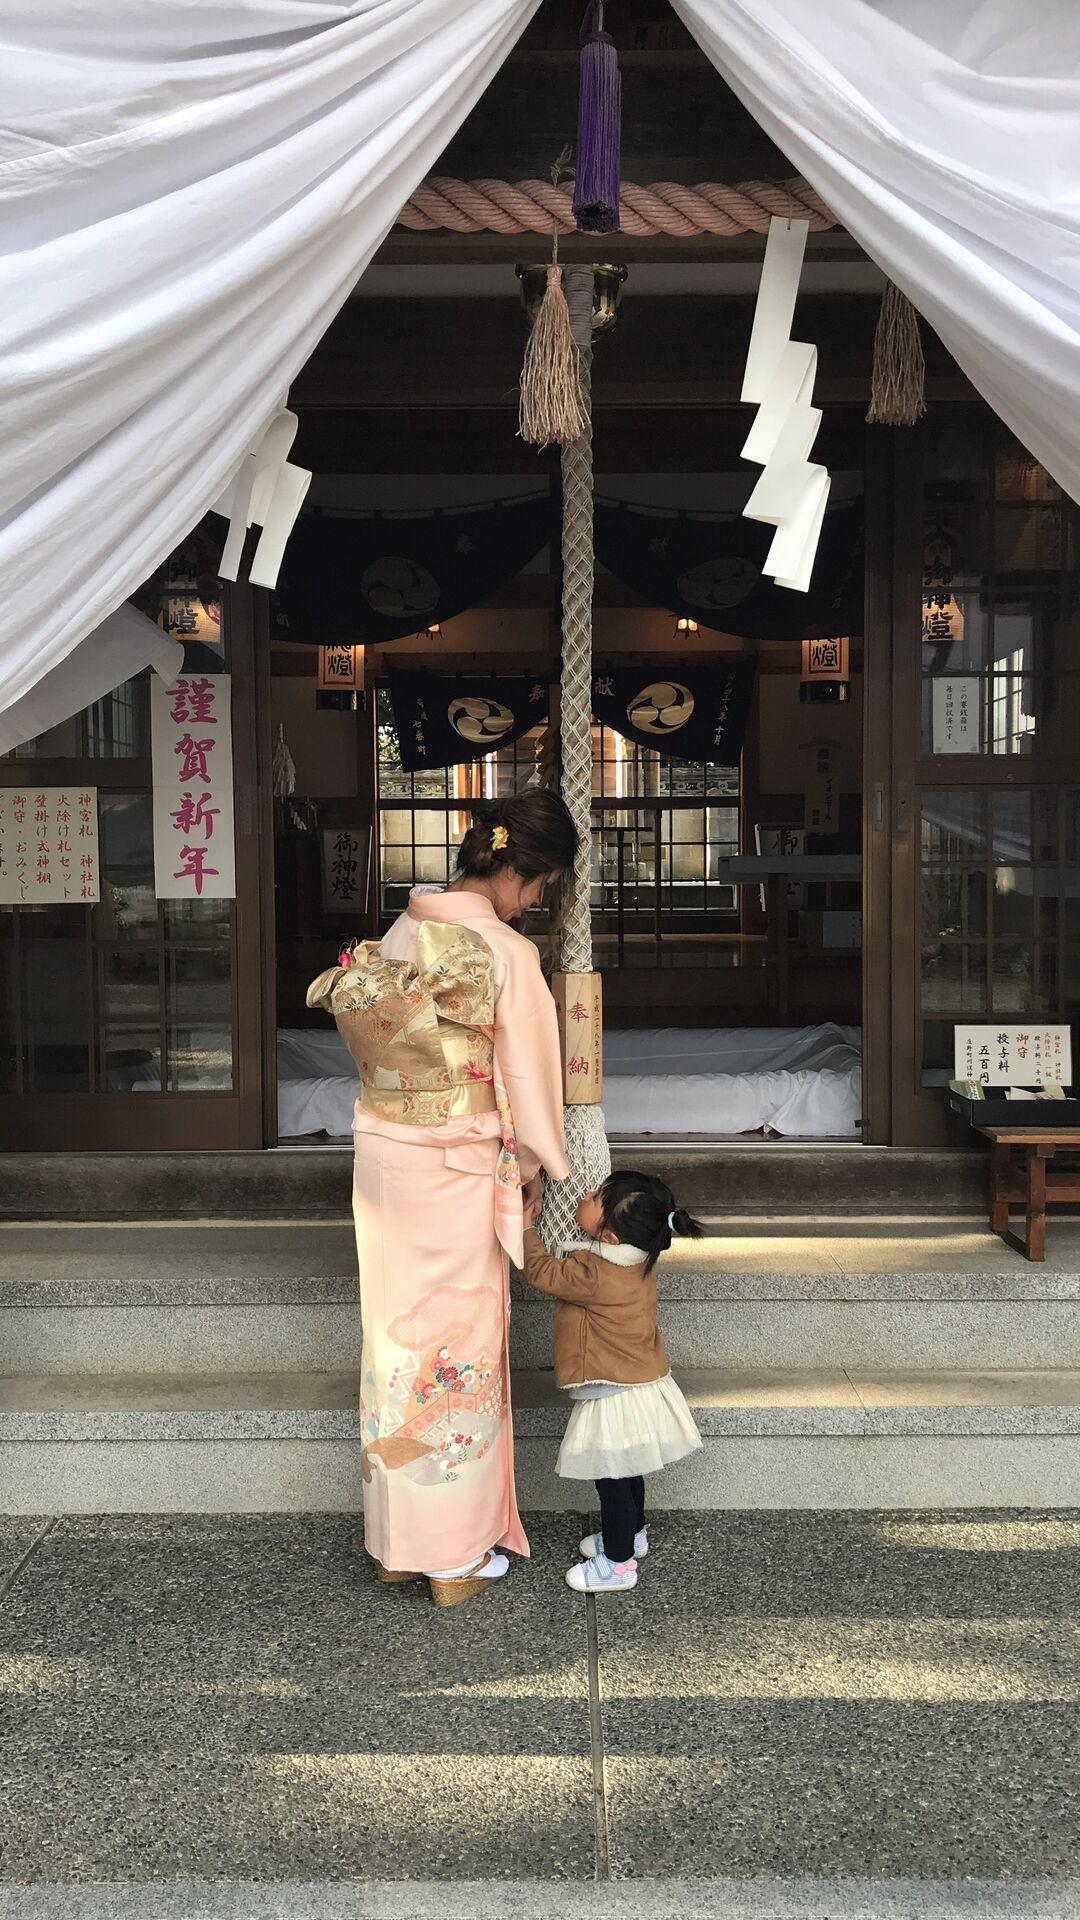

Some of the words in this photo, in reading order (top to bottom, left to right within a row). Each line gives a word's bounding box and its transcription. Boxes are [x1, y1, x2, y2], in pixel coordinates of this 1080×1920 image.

[812, 639, 838, 667] 燈
[528, 687, 545, 703] 奉
[960, 685, 968, 732] この賽銭箱は
[165, 678, 221, 895] 謹賀新年
[78, 793, 93, 837] 神宮札
[12, 796, 29, 900] 御守・おみくじ
[34, 793, 51, 884] 壁掛け式神棚
[57, 794, 72, 898] 火除け札セット
[80, 855, 95, 898] 神社札
[332, 832, 359, 900] 御神燈
[568, 1002, 589, 1075] 奉納
[997, 1033, 1010, 1072] 授与料
[1016, 1033, 1029, 1059] 御守
[979, 1045, 990, 1083] 五百円
